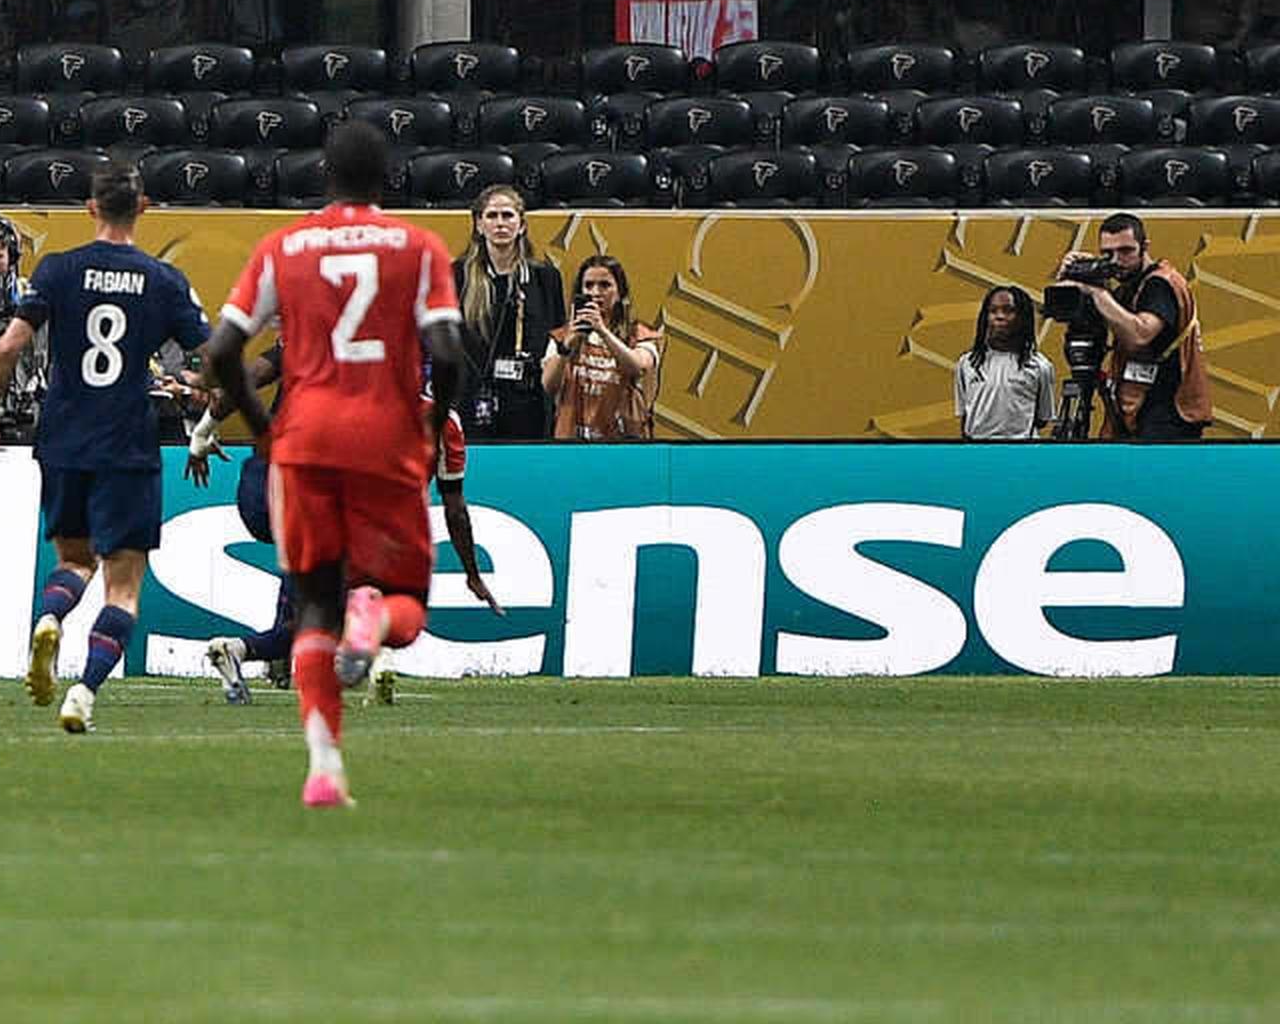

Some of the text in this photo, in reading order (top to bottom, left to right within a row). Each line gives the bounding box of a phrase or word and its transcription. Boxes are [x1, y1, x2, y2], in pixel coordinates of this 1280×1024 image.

[84, 269, 144, 295] FABIAN
[319, 253, 385, 362] 2
[81, 304, 127, 388] 8
